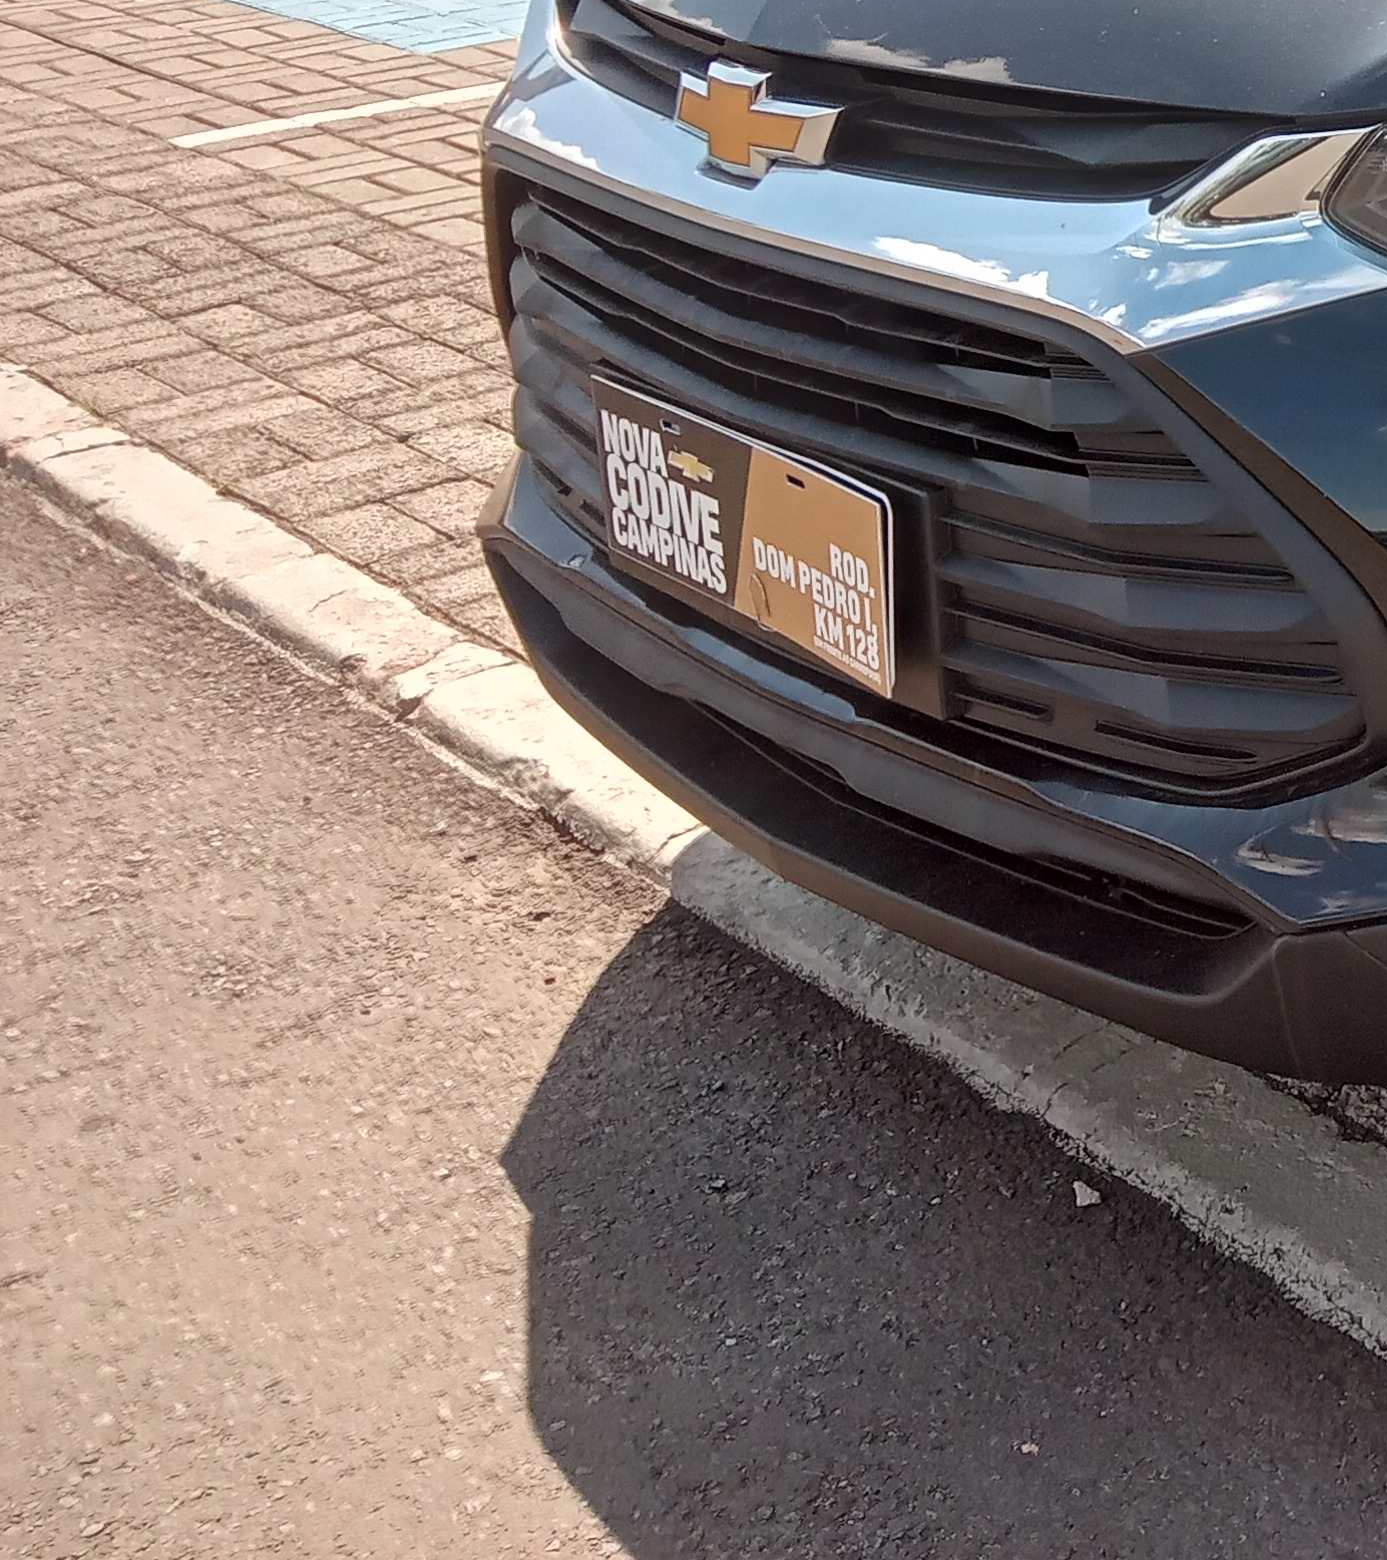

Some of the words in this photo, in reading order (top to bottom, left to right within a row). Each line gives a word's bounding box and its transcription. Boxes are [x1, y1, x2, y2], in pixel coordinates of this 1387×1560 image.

[600, 409, 668, 477] NOVA
[606, 453, 724, 556] CODIVE
[612, 506, 727, 594] CAMPINAS
[752, 536, 795, 589] DOM
[798, 560, 861, 623] PEDRO
[829, 543, 875, 599] ROD.
[814, 603, 844, 650] KM
[846, 623, 880, 670] 128
